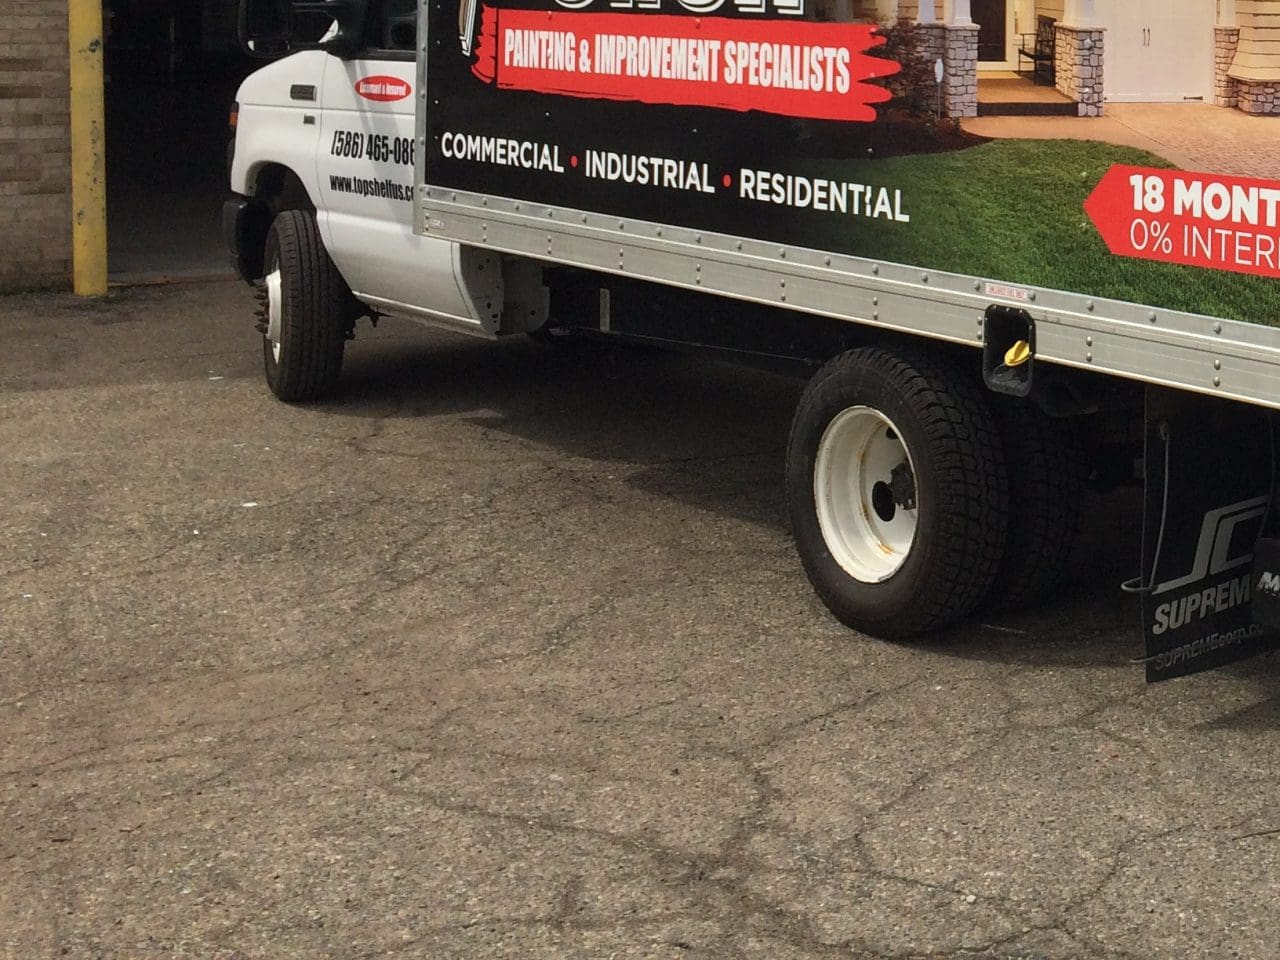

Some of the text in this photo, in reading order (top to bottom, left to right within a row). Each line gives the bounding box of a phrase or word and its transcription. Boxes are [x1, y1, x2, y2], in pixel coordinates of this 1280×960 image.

[504, 28, 851, 93] PAINTING & IMPROVEMENT SPECIALISTS
[330, 130, 364, 159] (586)
[441, 131, 909, 222] COMMERCIAL INDUSTRIAL RESIDENTIAL
[1129, 174, 1165, 213] 18
[1130, 218, 1173, 254] 0%
